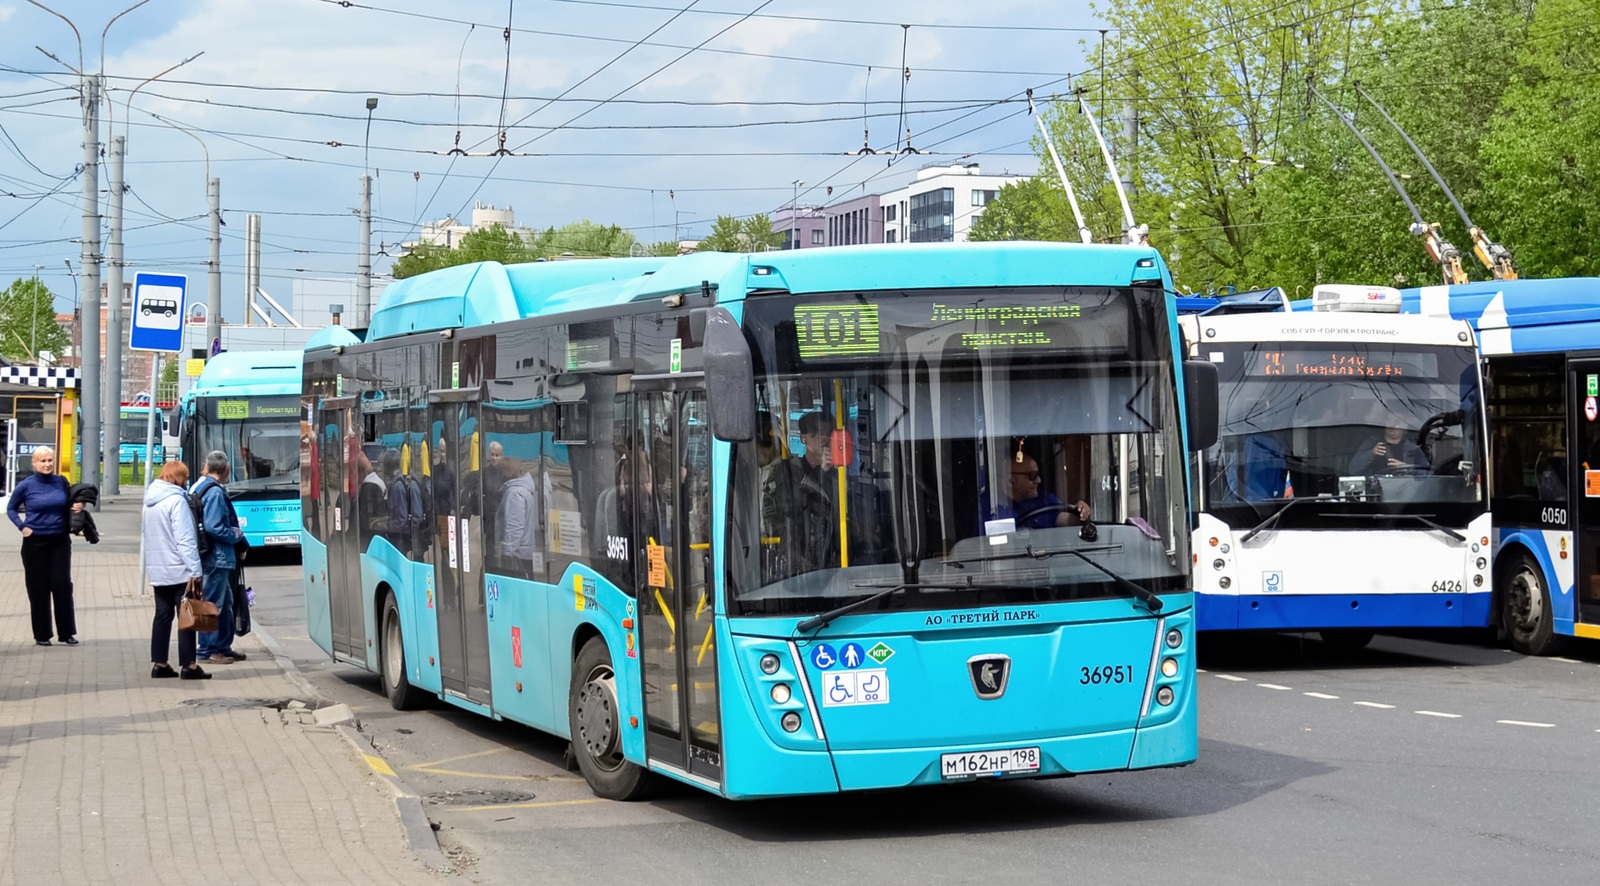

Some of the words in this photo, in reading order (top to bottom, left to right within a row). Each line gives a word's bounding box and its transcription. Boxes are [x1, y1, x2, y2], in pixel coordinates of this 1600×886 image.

[930, 302, 1080, 325] Ленинградская
[797, 308, 864, 350] 101
[962, 332, 1051, 350] пристань
[20, 445, 38, 454] БИ
[1541, 507, 1567, 525] 6050
[607, 535, 629, 561] 36951
[1431, 580, 1462, 593] 6426
[925, 615, 943, 625] АО
[946, 609, 1000, 624] «ТРЕТИЙ
[1003, 610, 1041, 621] ПАРК»
[872, 648, 889, 658] КПГ
[1079, 665, 1134, 685] 36951
[946, 754, 1009, 773] М162НР
[1012, 749, 1036, 763] 198
